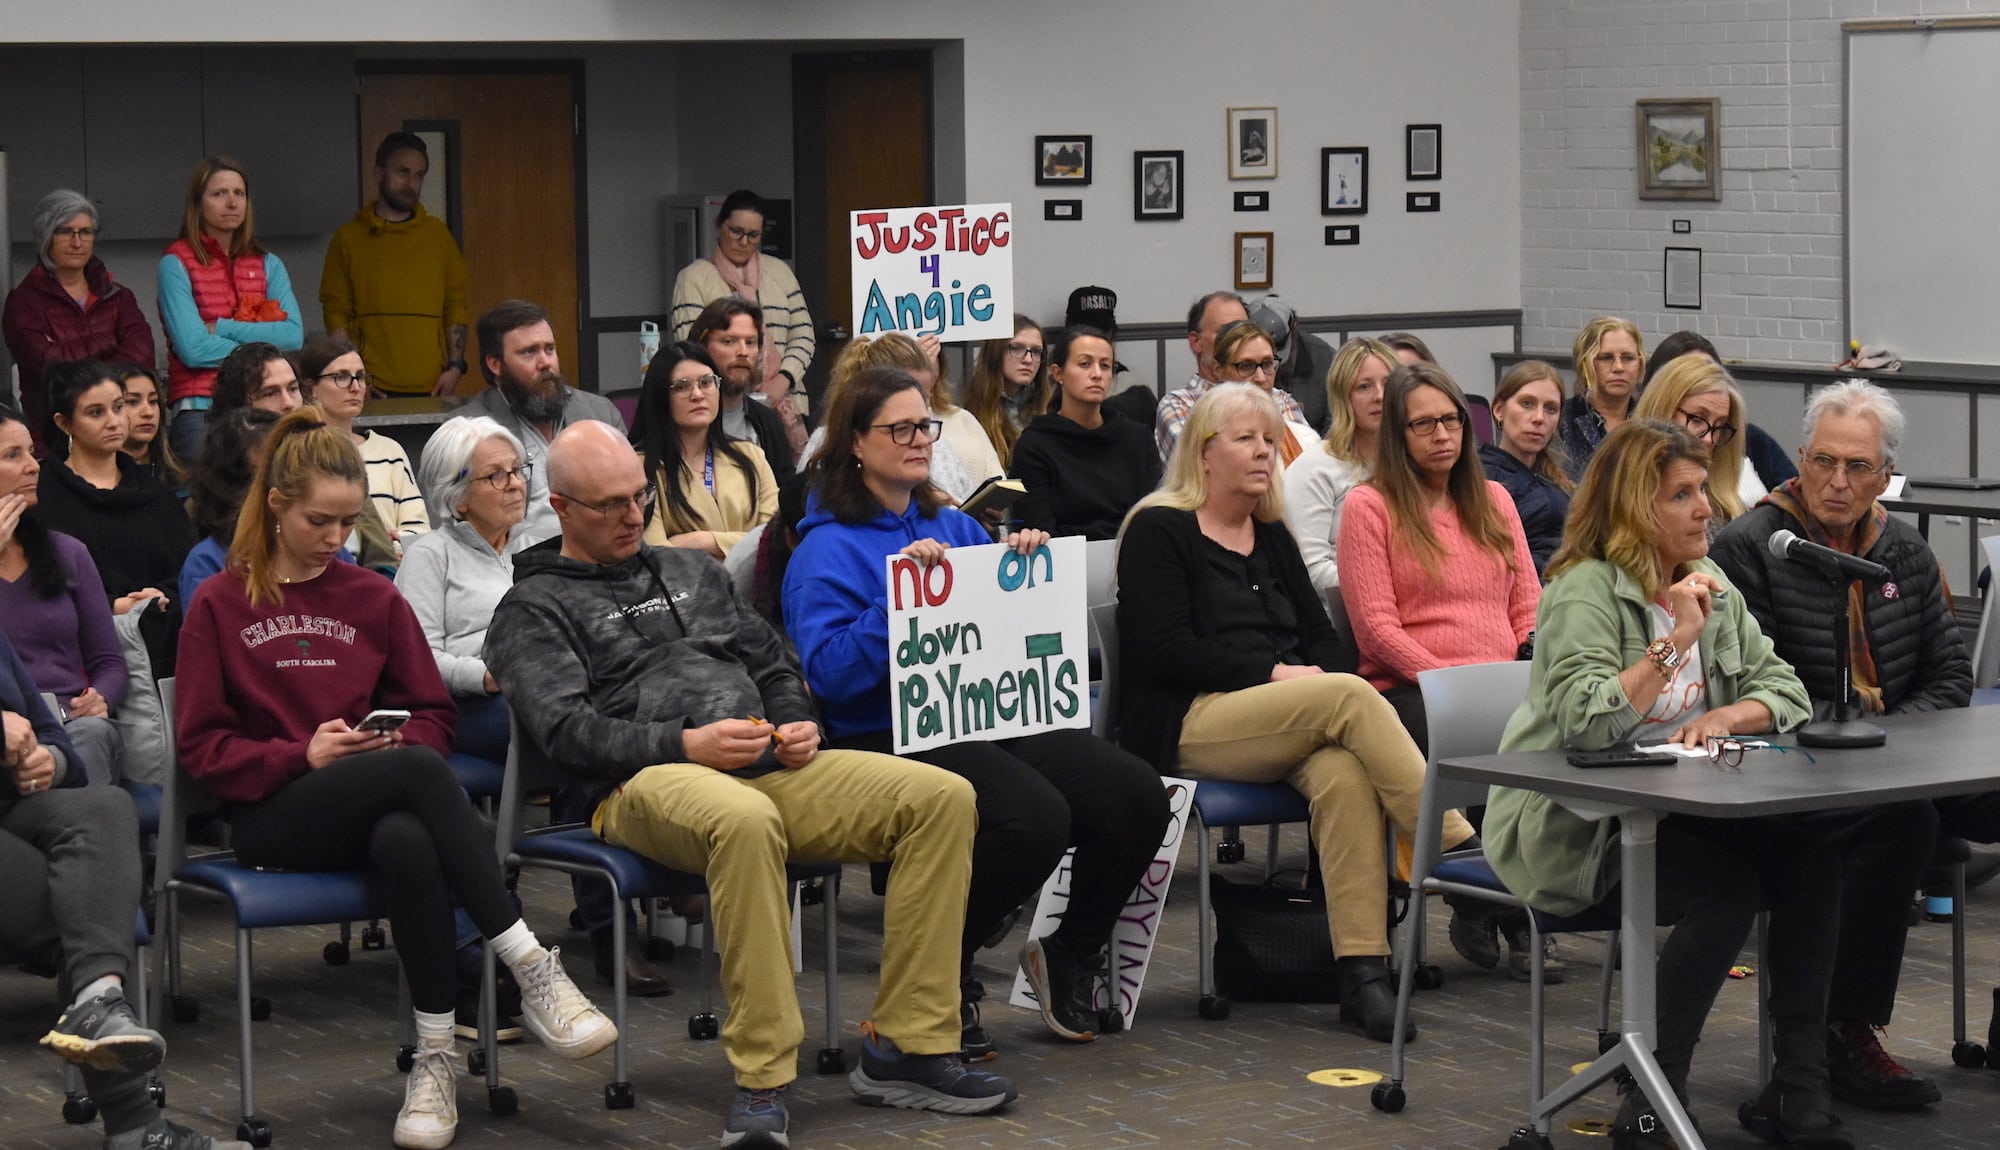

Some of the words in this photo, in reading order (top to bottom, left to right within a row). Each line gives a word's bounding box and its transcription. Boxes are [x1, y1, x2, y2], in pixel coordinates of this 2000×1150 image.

[920, 254, 940, 288] 4
[860, 278, 995, 337] Angie
[1080, 294, 1116, 311] BASALT
[892, 557, 954, 611] no
[997, 543, 1053, 592] on
[240, 614, 357, 649] CHARLESTON
[896, 616, 982, 668] down
[276, 659, 300, 668] SOUTH
[301, 658, 337, 667] CAROLINA
